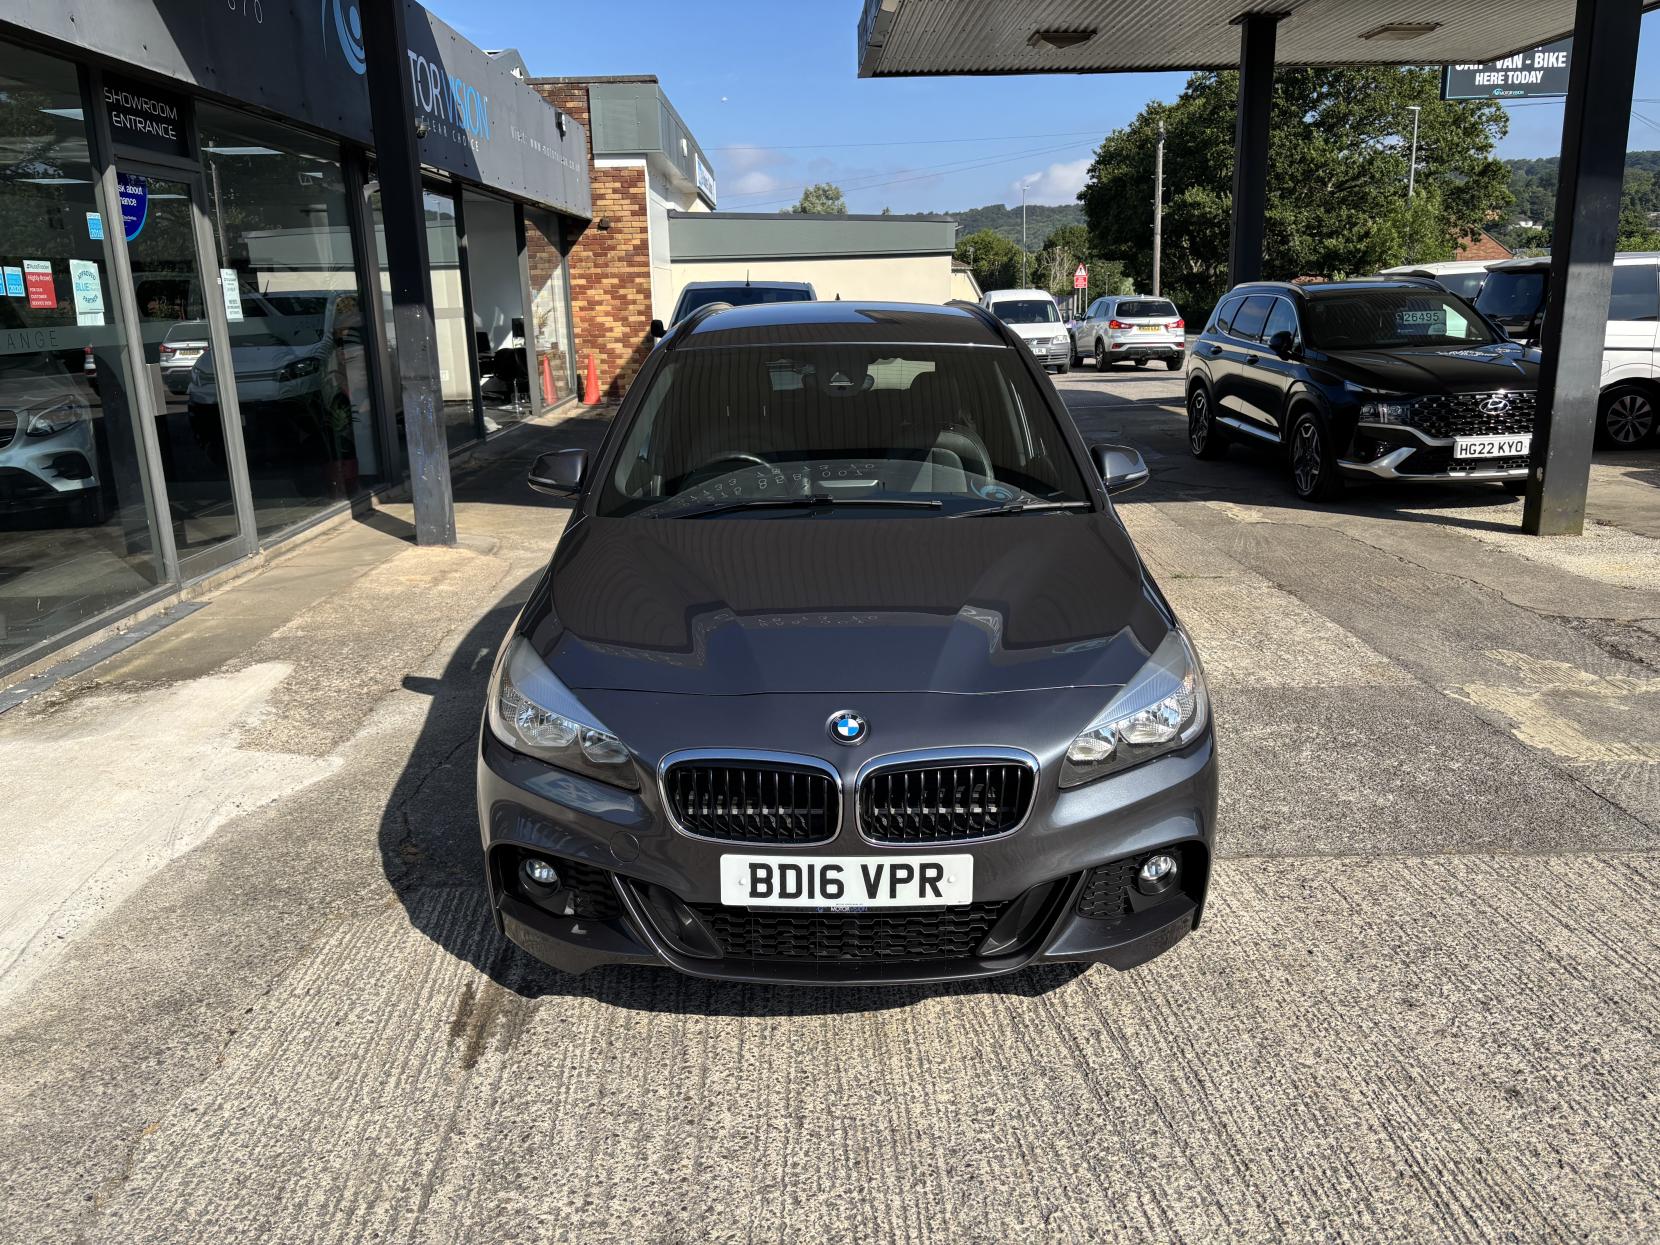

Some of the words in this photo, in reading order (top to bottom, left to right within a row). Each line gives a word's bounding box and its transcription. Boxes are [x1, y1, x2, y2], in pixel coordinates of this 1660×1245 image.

[1496, 54, 1523, 69] VAN
[1534, 51, 1568, 68] BIKE
[1475, 72, 1505, 85] HERE
[1508, 71, 1544, 84] TODAY
[103, 87, 178, 120] SHOWROOM
[112, 111, 177, 140] ENTRANCE
[452, 129, 480, 152] CHOICE
[126, 183, 143, 195] about
[77, 270, 97, 281] APPROVED
[75, 282, 90, 291] BLUE
[1459, 442, 1494, 456] HG22
[1498, 440, 1523, 453] KYO
[748, 862, 845, 899] BD16
[860, 862, 944, 899] VPR
